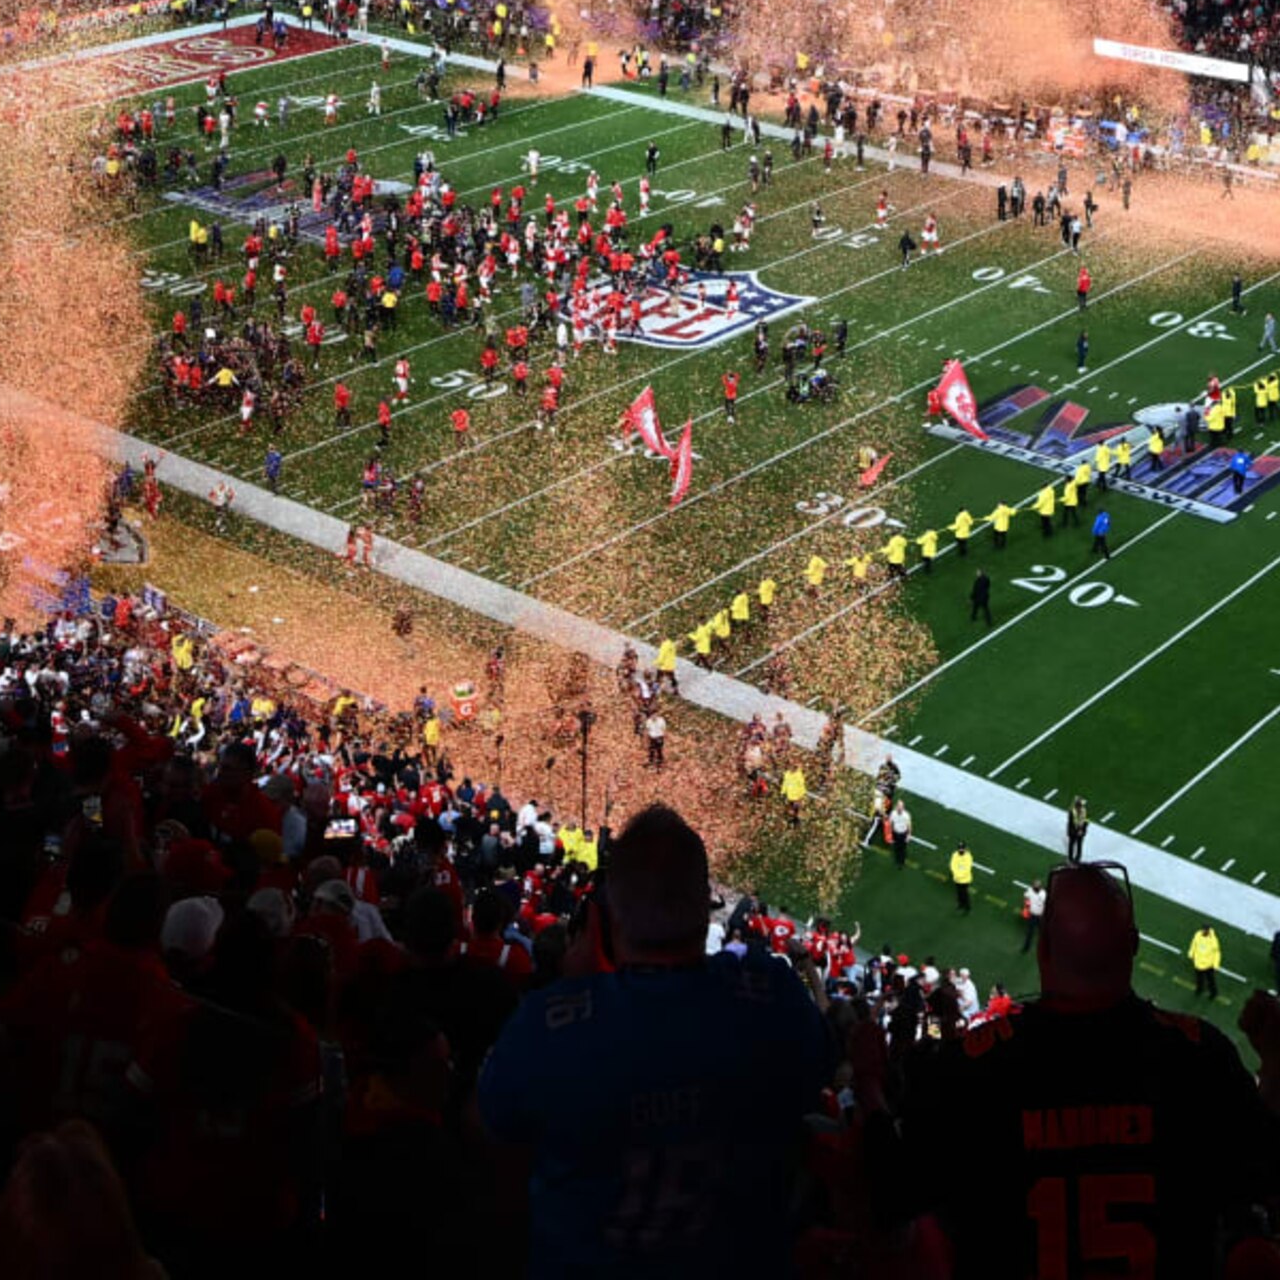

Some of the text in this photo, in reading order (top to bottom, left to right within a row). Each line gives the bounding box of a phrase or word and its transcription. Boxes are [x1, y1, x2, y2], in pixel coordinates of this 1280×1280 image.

[795, 492, 887, 529] 30
[1010, 563, 1118, 610] 20
[1025, 1173, 1158, 1280] 15
